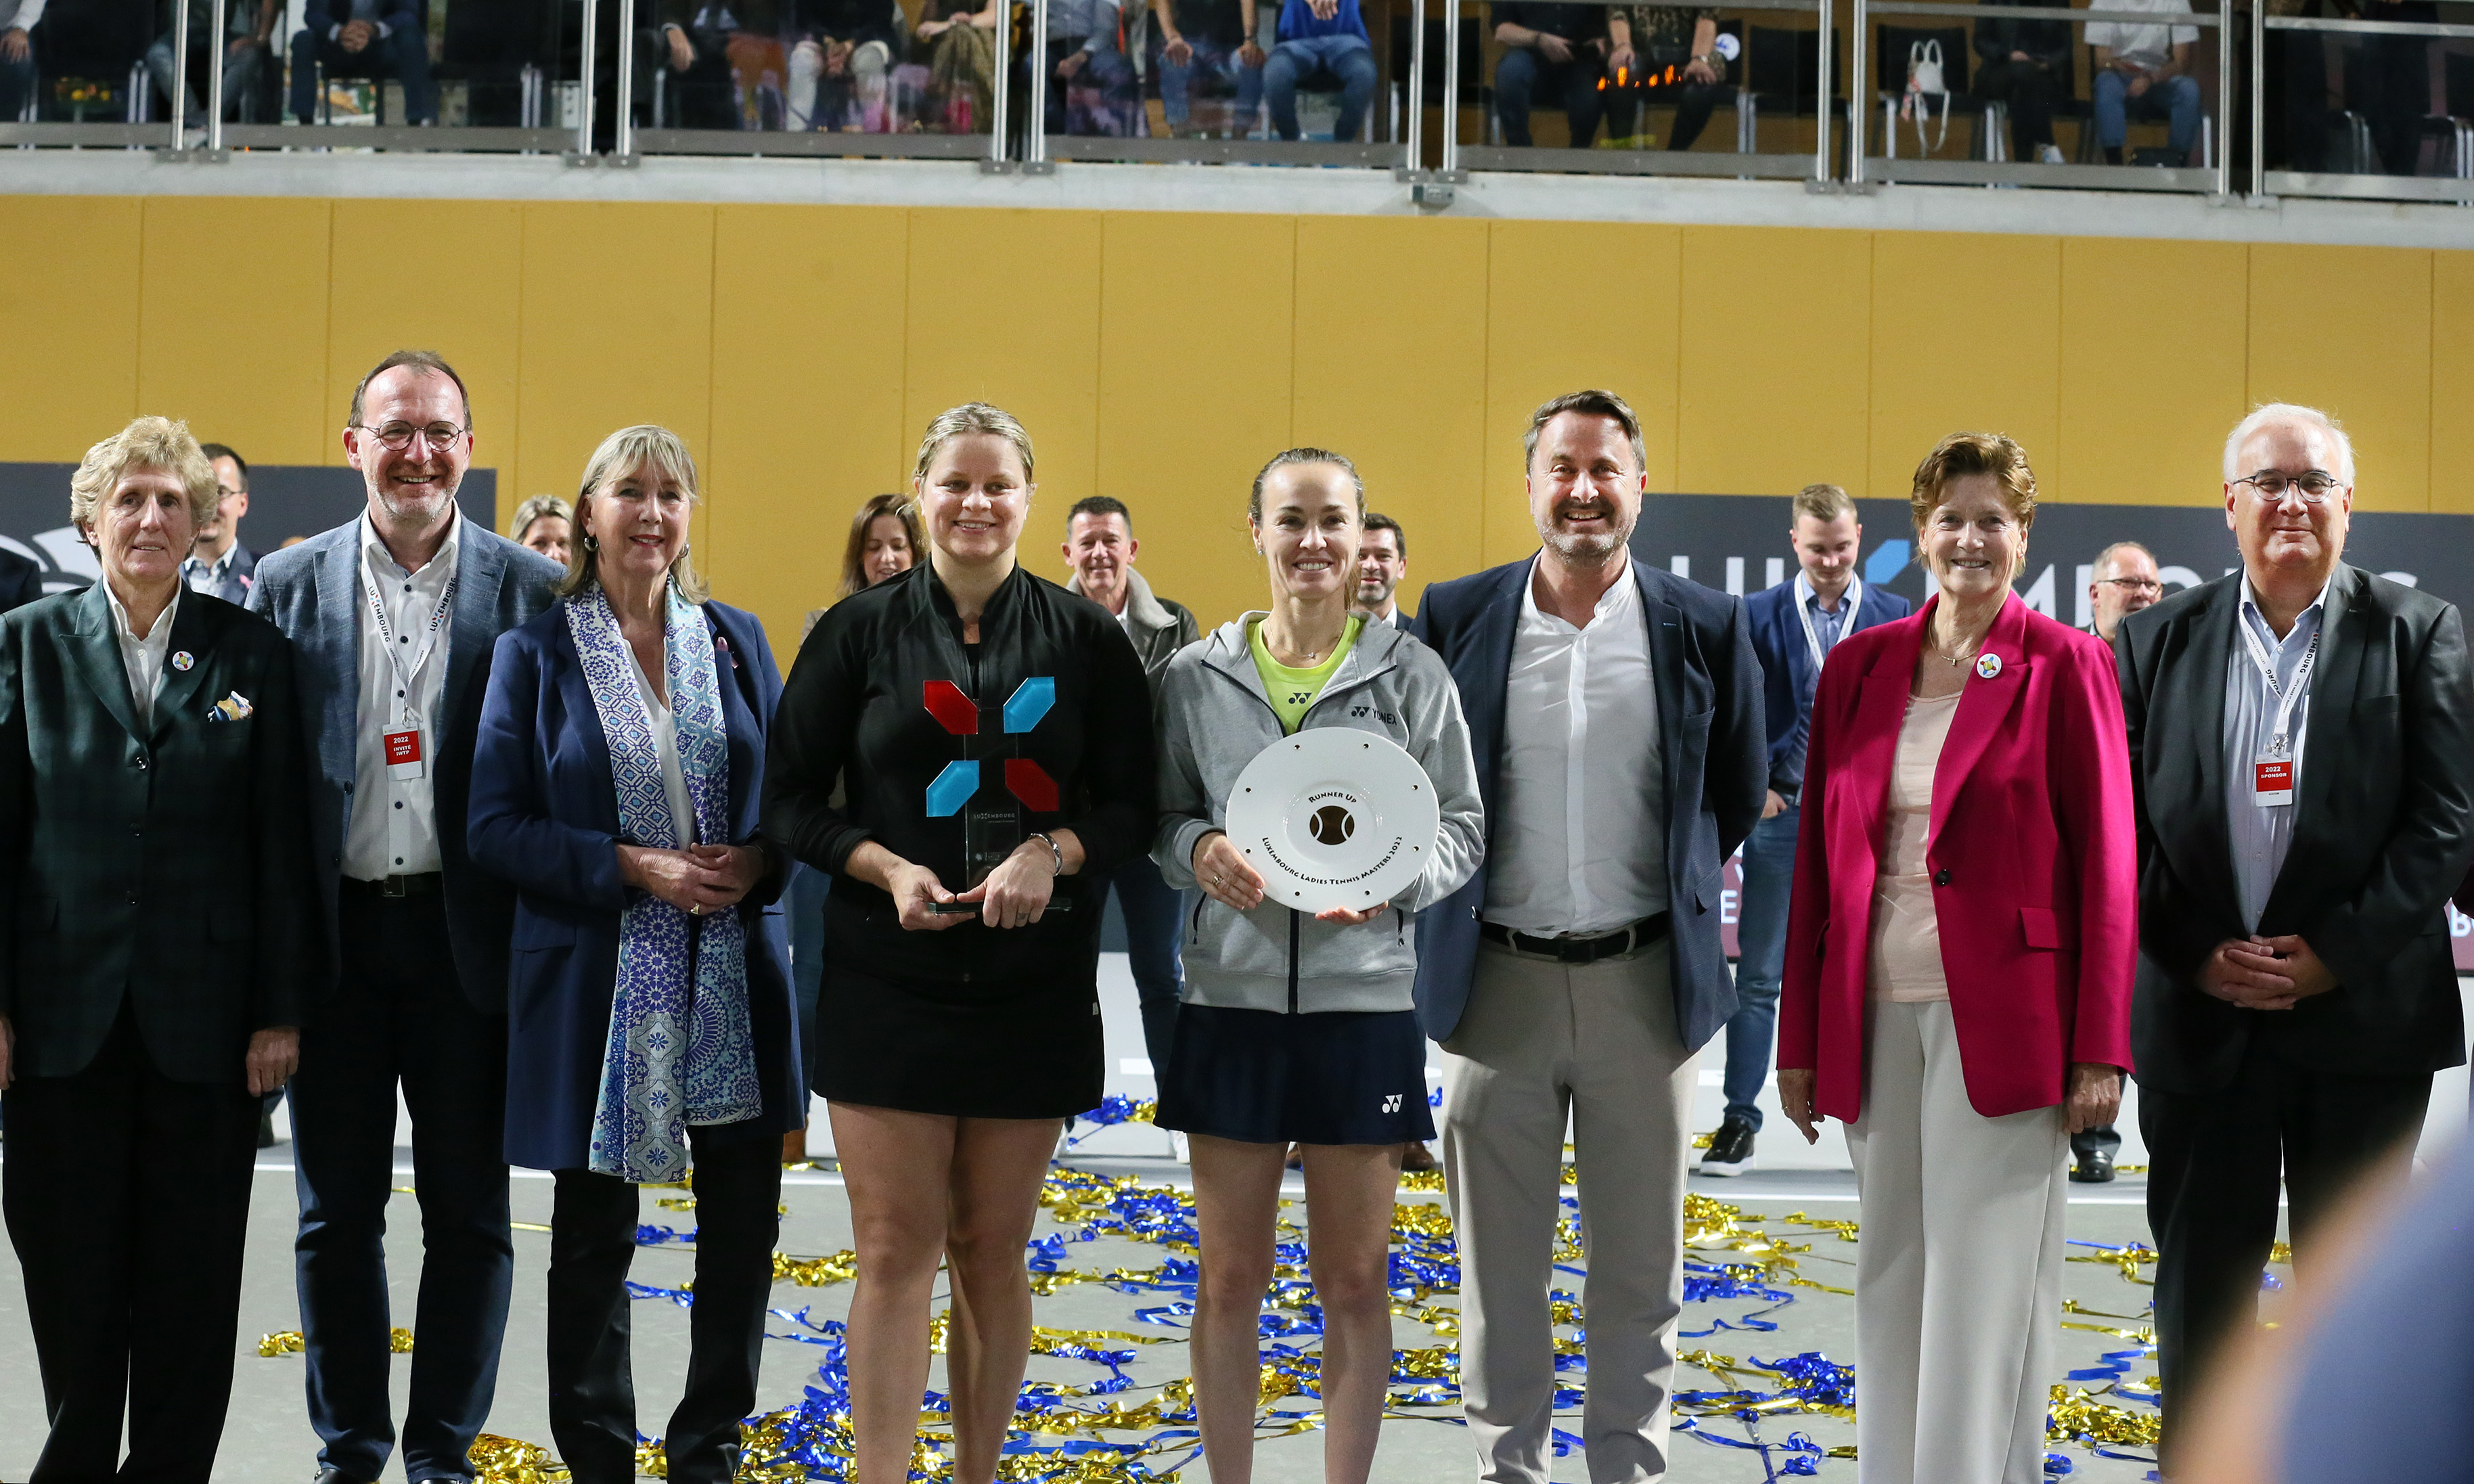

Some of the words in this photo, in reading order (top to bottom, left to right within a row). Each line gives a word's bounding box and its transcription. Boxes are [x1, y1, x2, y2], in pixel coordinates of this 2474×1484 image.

[369, 586, 390, 642] LUXEMBOURG
[1372, 708, 1397, 725] YONEX
[1308, 792, 1343, 803] RUNNER
[1345, 794, 1357, 803] UP
[1262, 837, 1299, 877] LUXEMBOURG
[1301, 874, 1327, 884] LADIES
[1329, 876, 1359, 884] TENNIS
[1361, 855, 1391, 878] MASTERS
[1389, 836, 1402, 855] 2022
